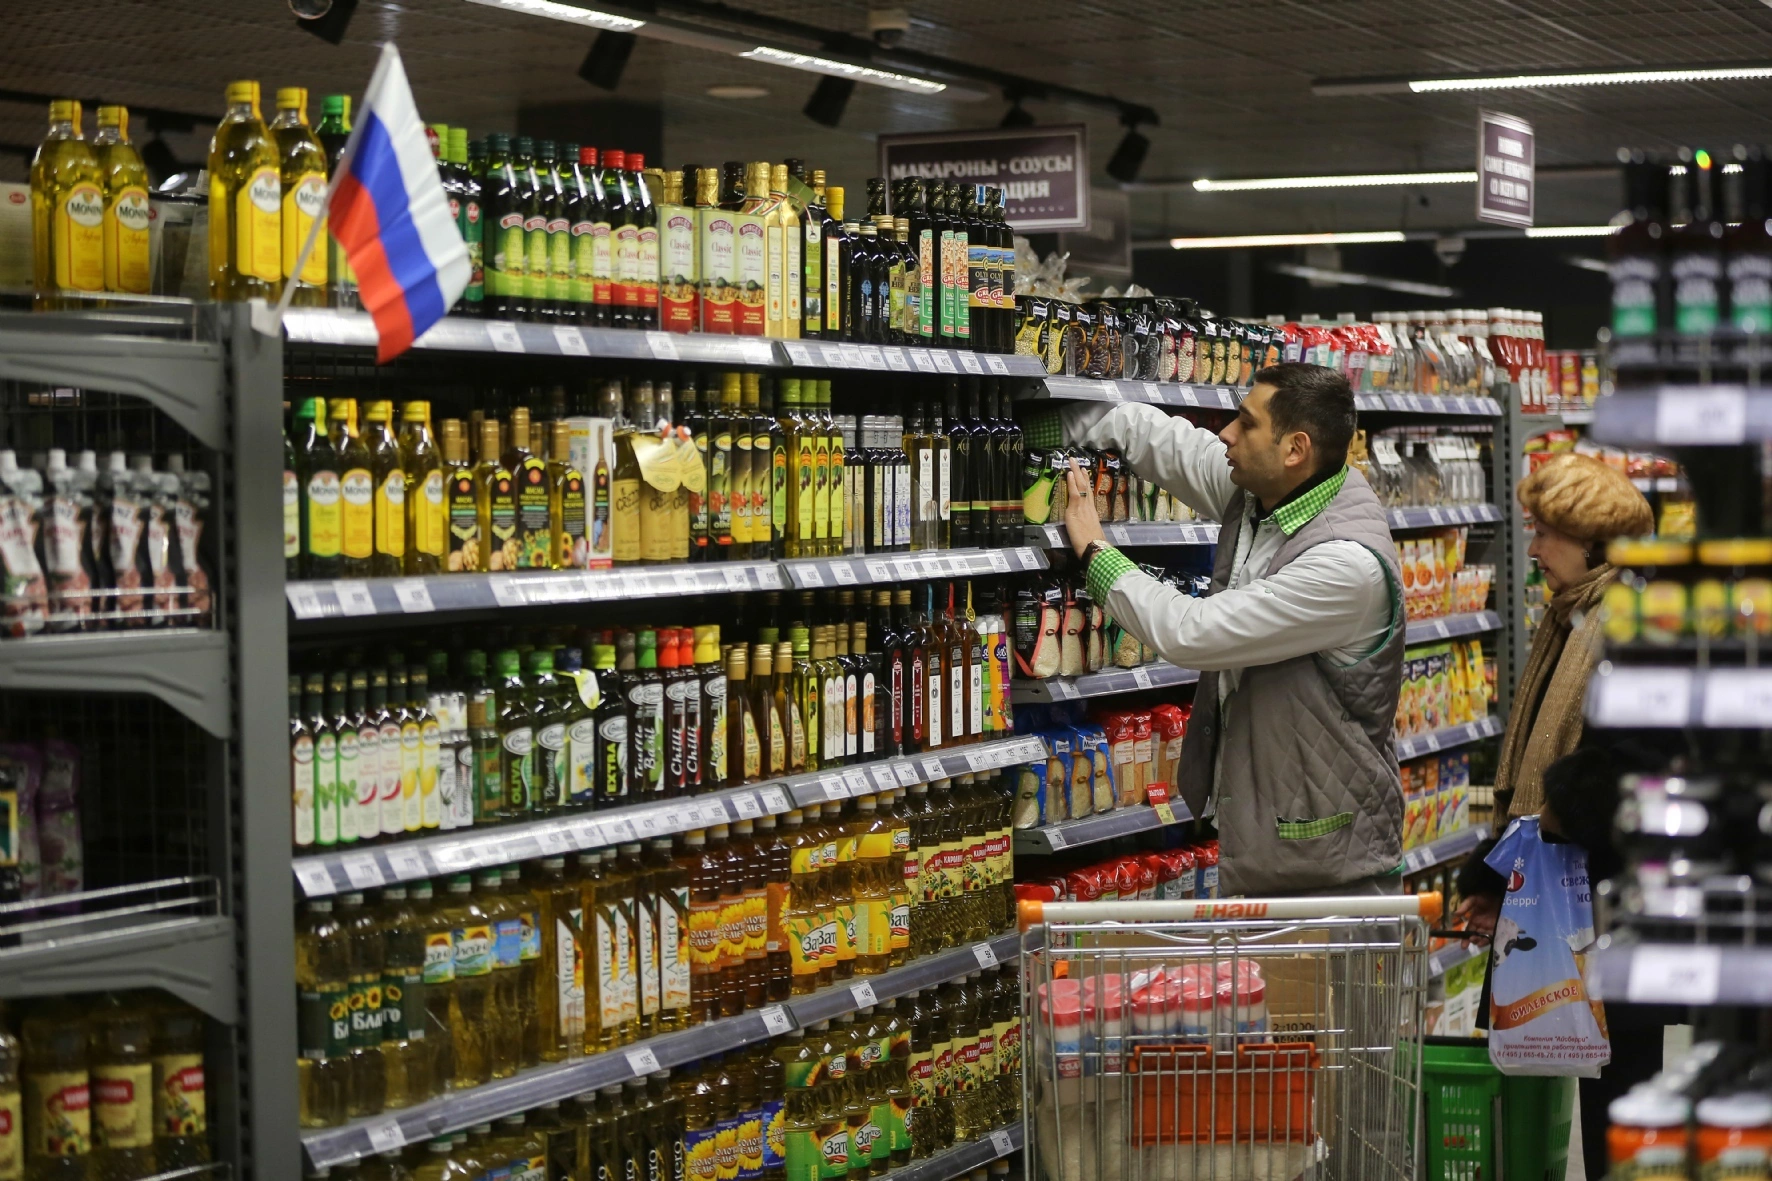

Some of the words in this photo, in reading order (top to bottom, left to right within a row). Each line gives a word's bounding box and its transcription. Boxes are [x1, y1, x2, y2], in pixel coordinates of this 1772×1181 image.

[891, 159, 998, 181] МАКАРОНЫ
[1009, 154, 1074, 175] СОУСЫ
[606, 742, 617, 793] EXTRA
[643, 727, 656, 770] Basil
[670, 728, 682, 776] Chilli
[686, 725, 698, 773] Chilli
[511, 759, 521, 804] OLIVA
[664, 914, 678, 976] Altero
[1510, 986, 1579, 1021] ФИЛЕВСКОЕ
